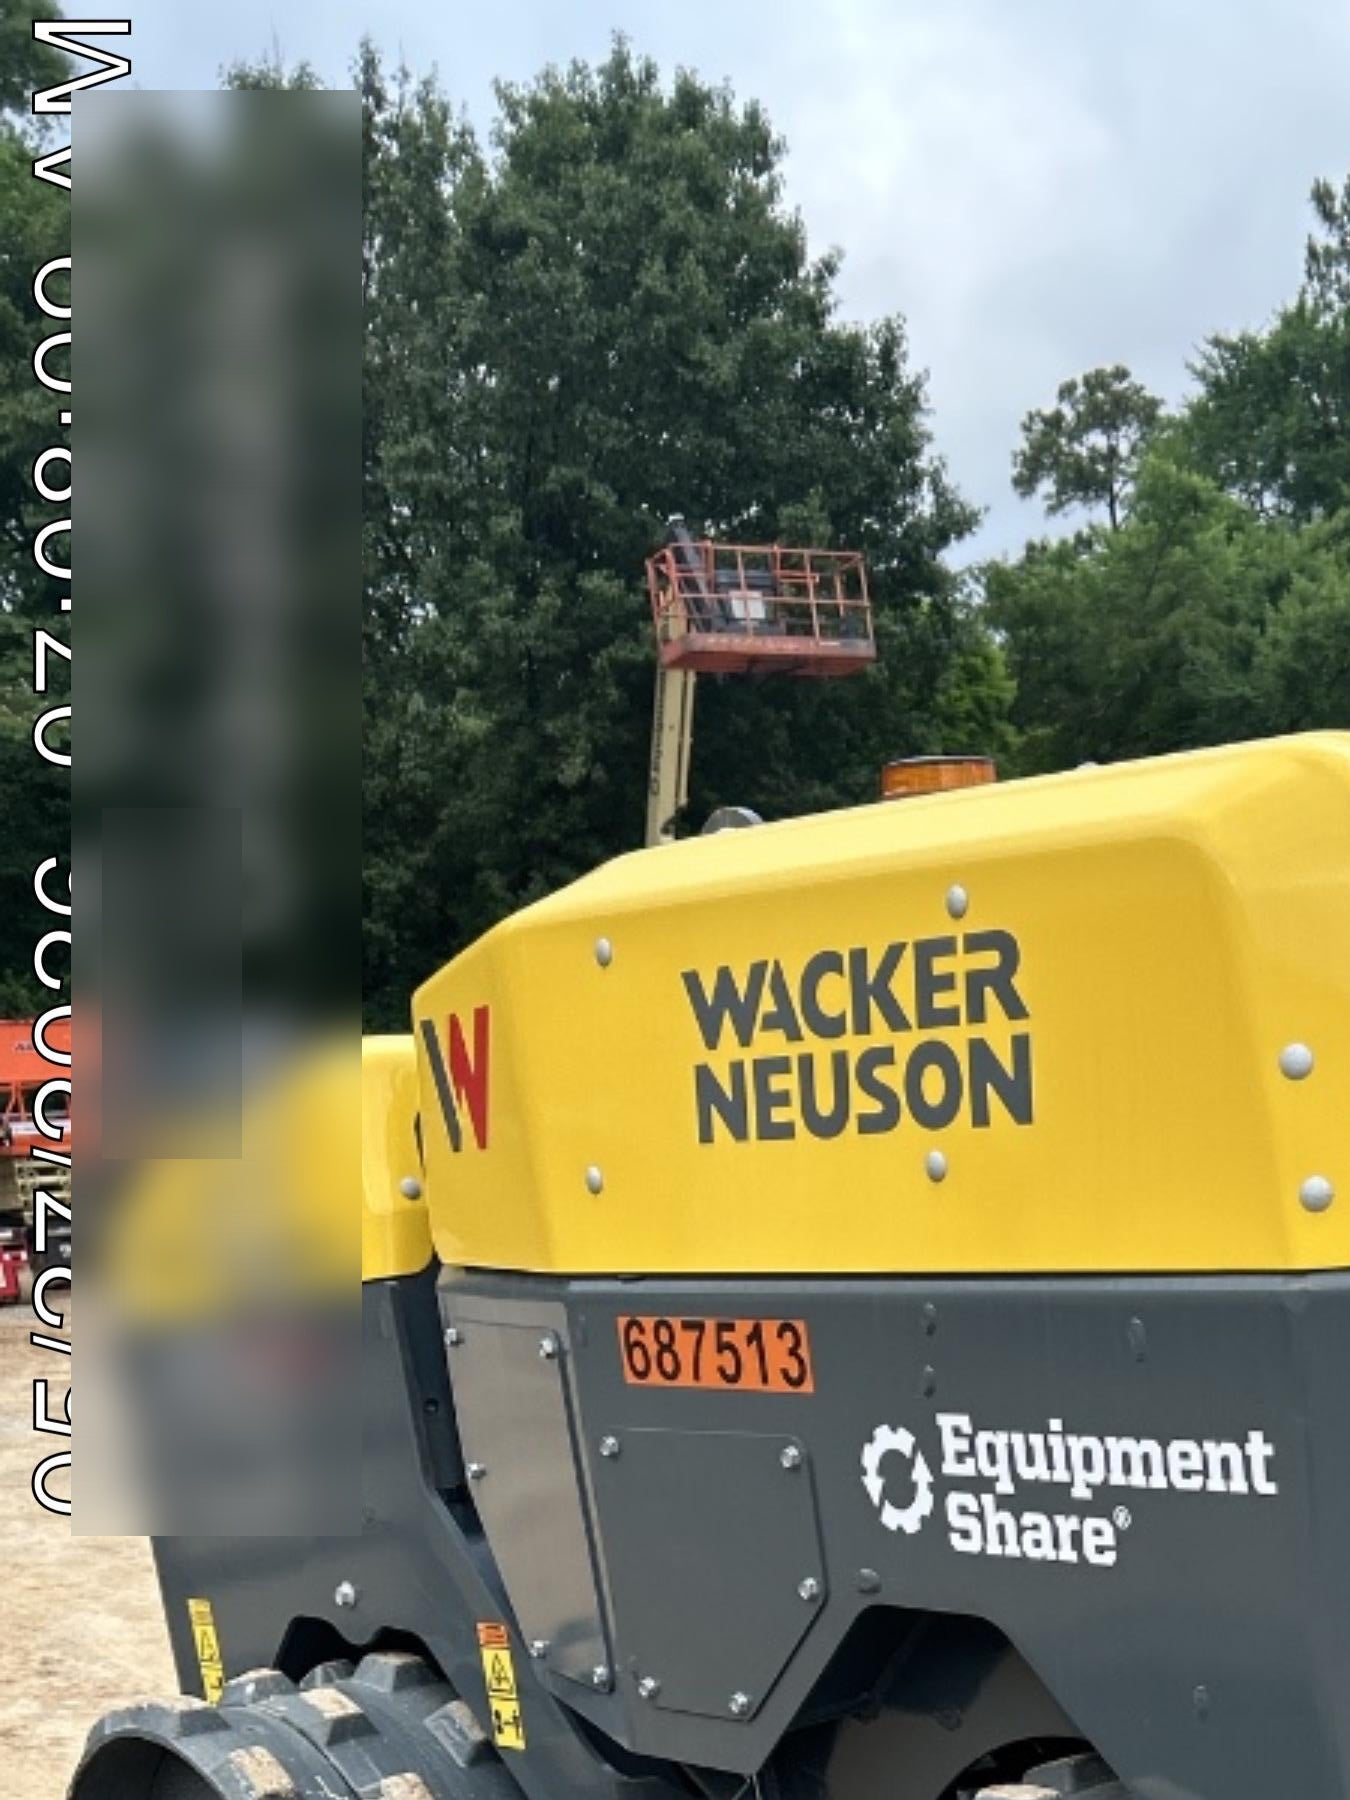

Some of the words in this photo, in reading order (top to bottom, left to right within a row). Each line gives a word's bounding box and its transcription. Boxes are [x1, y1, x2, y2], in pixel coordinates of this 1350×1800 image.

[681, 929, 1030, 1050] WACKER
[695, 1033, 1034, 1144] NEUSON
[624, 1317, 808, 1389] 687513
[935, 1412, 1278, 1500] Equipment
